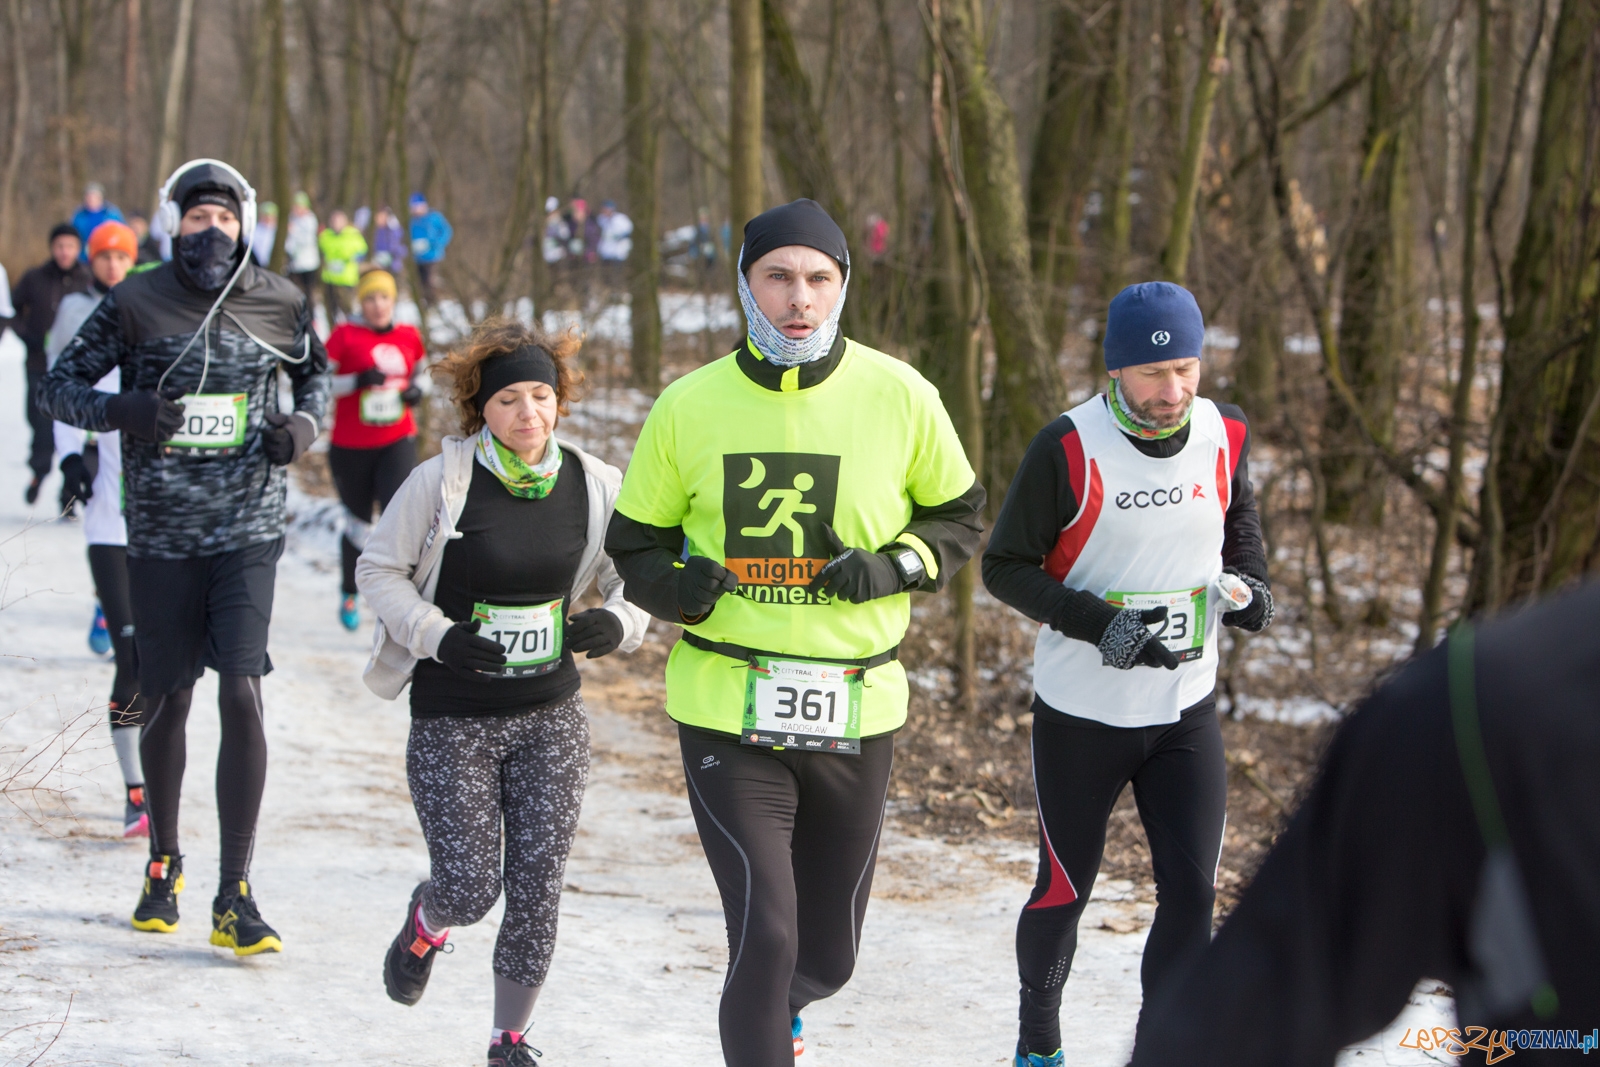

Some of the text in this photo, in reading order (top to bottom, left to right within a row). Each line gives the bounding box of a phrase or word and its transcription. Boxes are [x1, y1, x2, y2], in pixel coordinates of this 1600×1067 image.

[1115, 486, 1183, 510] ecco
[747, 559, 816, 584] night
[491, 627, 547, 655] 1701
[774, 686, 836, 723] 361
[781, 722, 828, 734] RADOSŁAW
